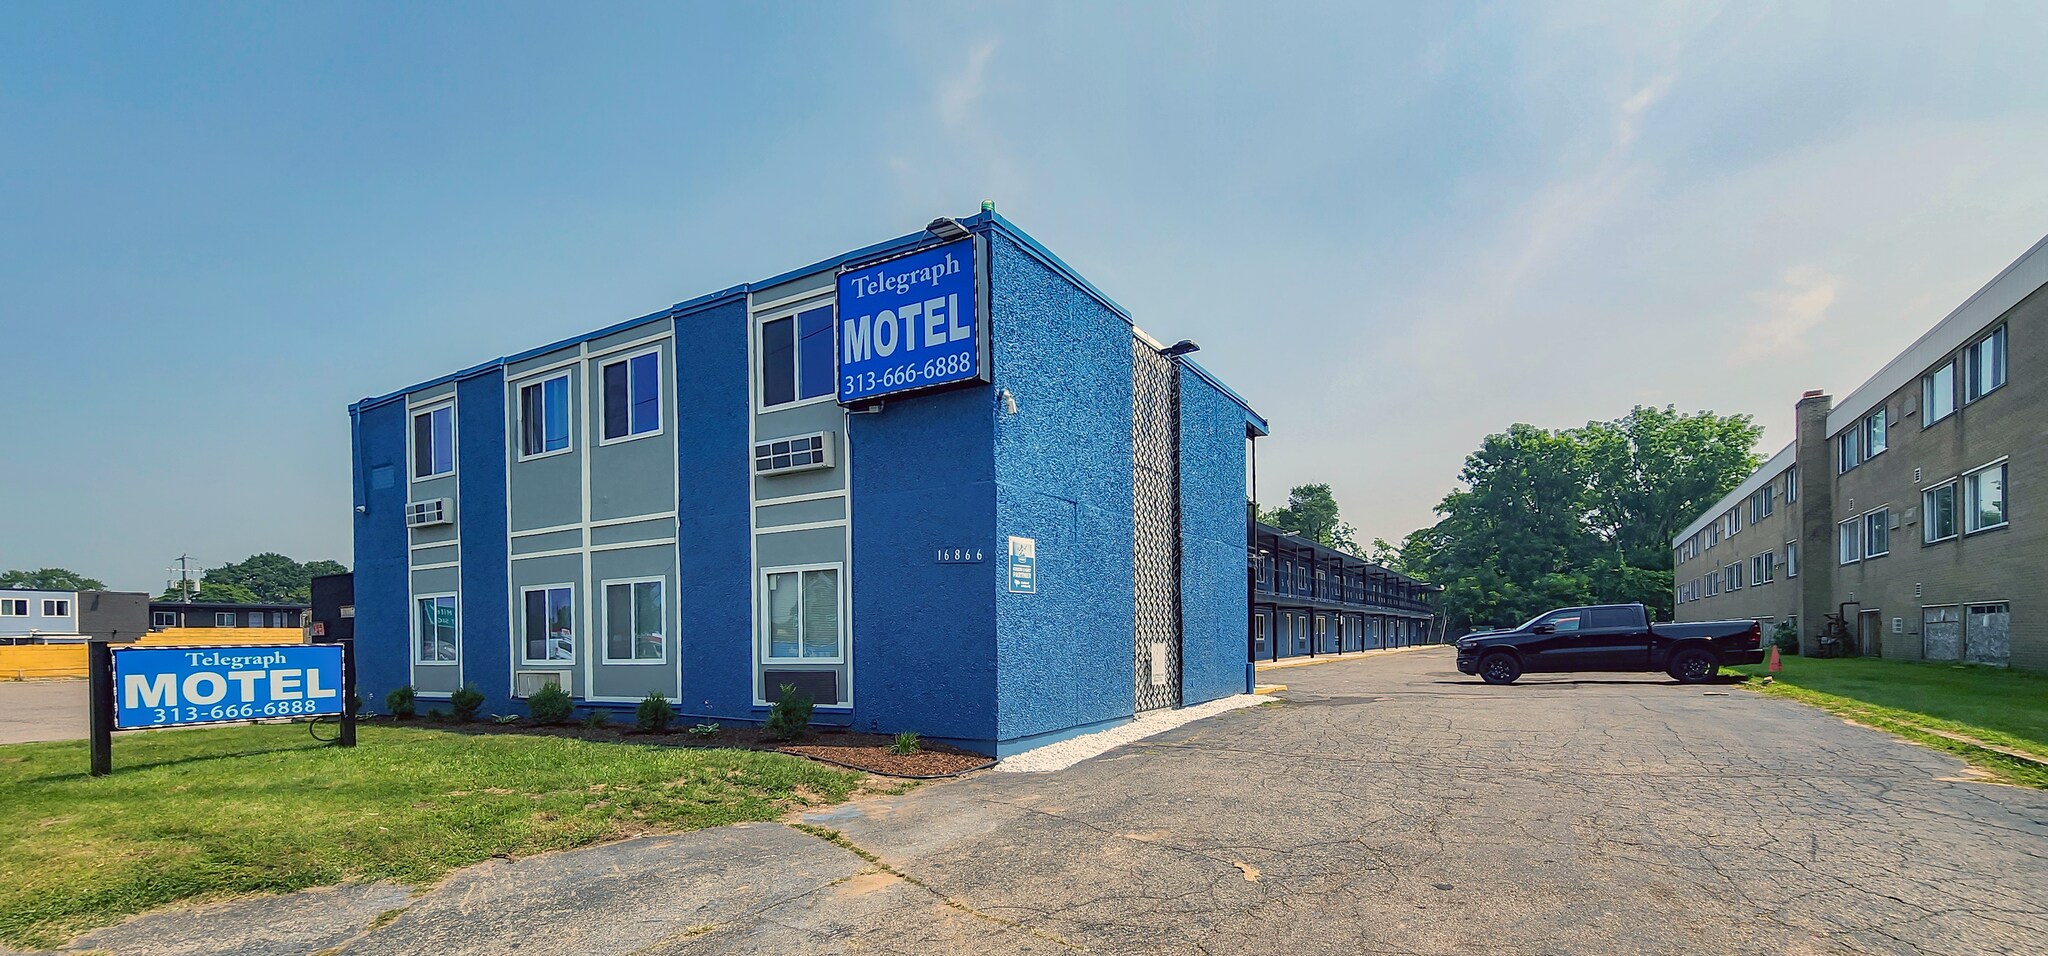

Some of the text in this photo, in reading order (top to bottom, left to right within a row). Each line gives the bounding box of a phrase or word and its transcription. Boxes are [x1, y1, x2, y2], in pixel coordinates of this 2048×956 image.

[851, 253, 960, 298] Telegraph
[844, 293, 971, 365] MOTEL
[845, 351, 971, 395] 313-666-6888
[937, 549, 982, 561] 16866
[185, 651, 287, 669] Telegraph
[124, 668, 336, 709] MOTEL
[153, 700, 317, 723] 313-666-6888
